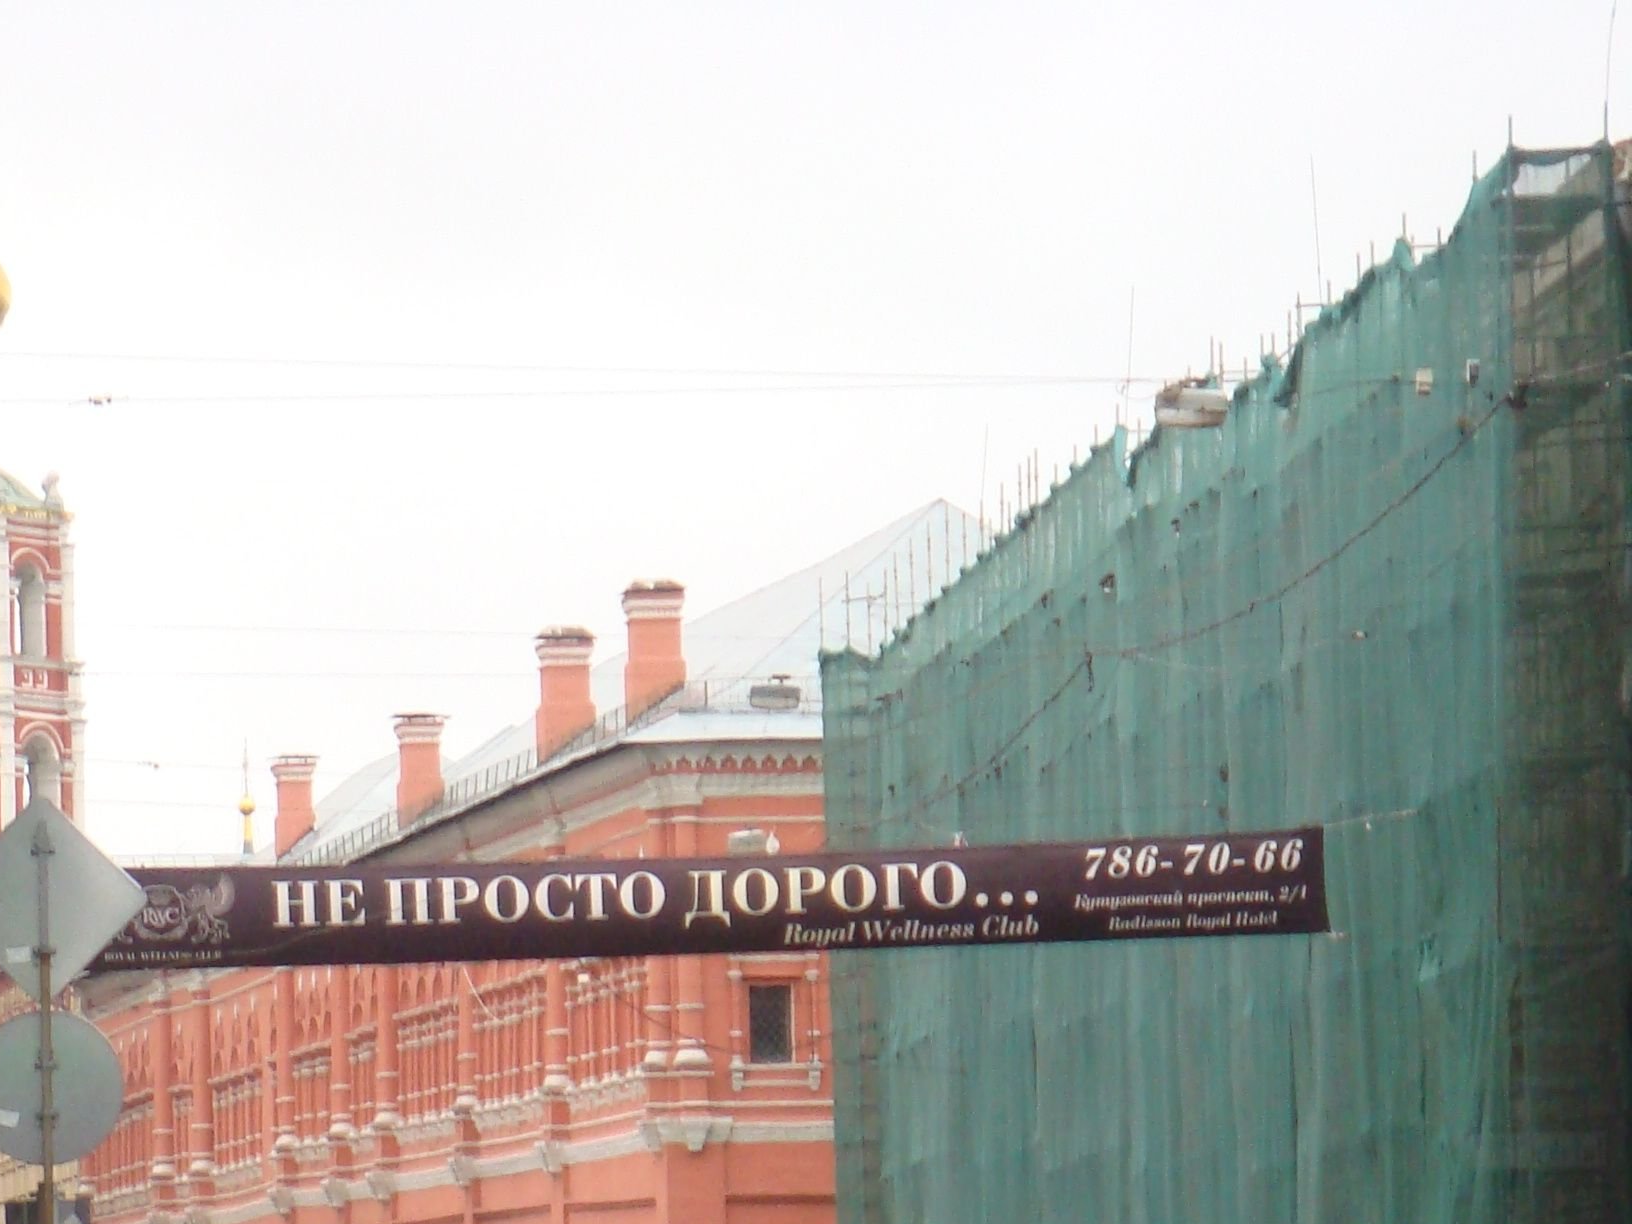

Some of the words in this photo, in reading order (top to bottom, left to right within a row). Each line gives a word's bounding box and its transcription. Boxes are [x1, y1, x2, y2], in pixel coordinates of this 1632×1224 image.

[270, 879, 366, 929] НЕ
[385, 870, 665, 926] ПРОСТО
[684, 860, 1040, 930] ДОРОГО...
[784, 921, 856, 947] Royal
[862, 917, 975, 943] Wellness
[982, 913, 1040, 937] Club
